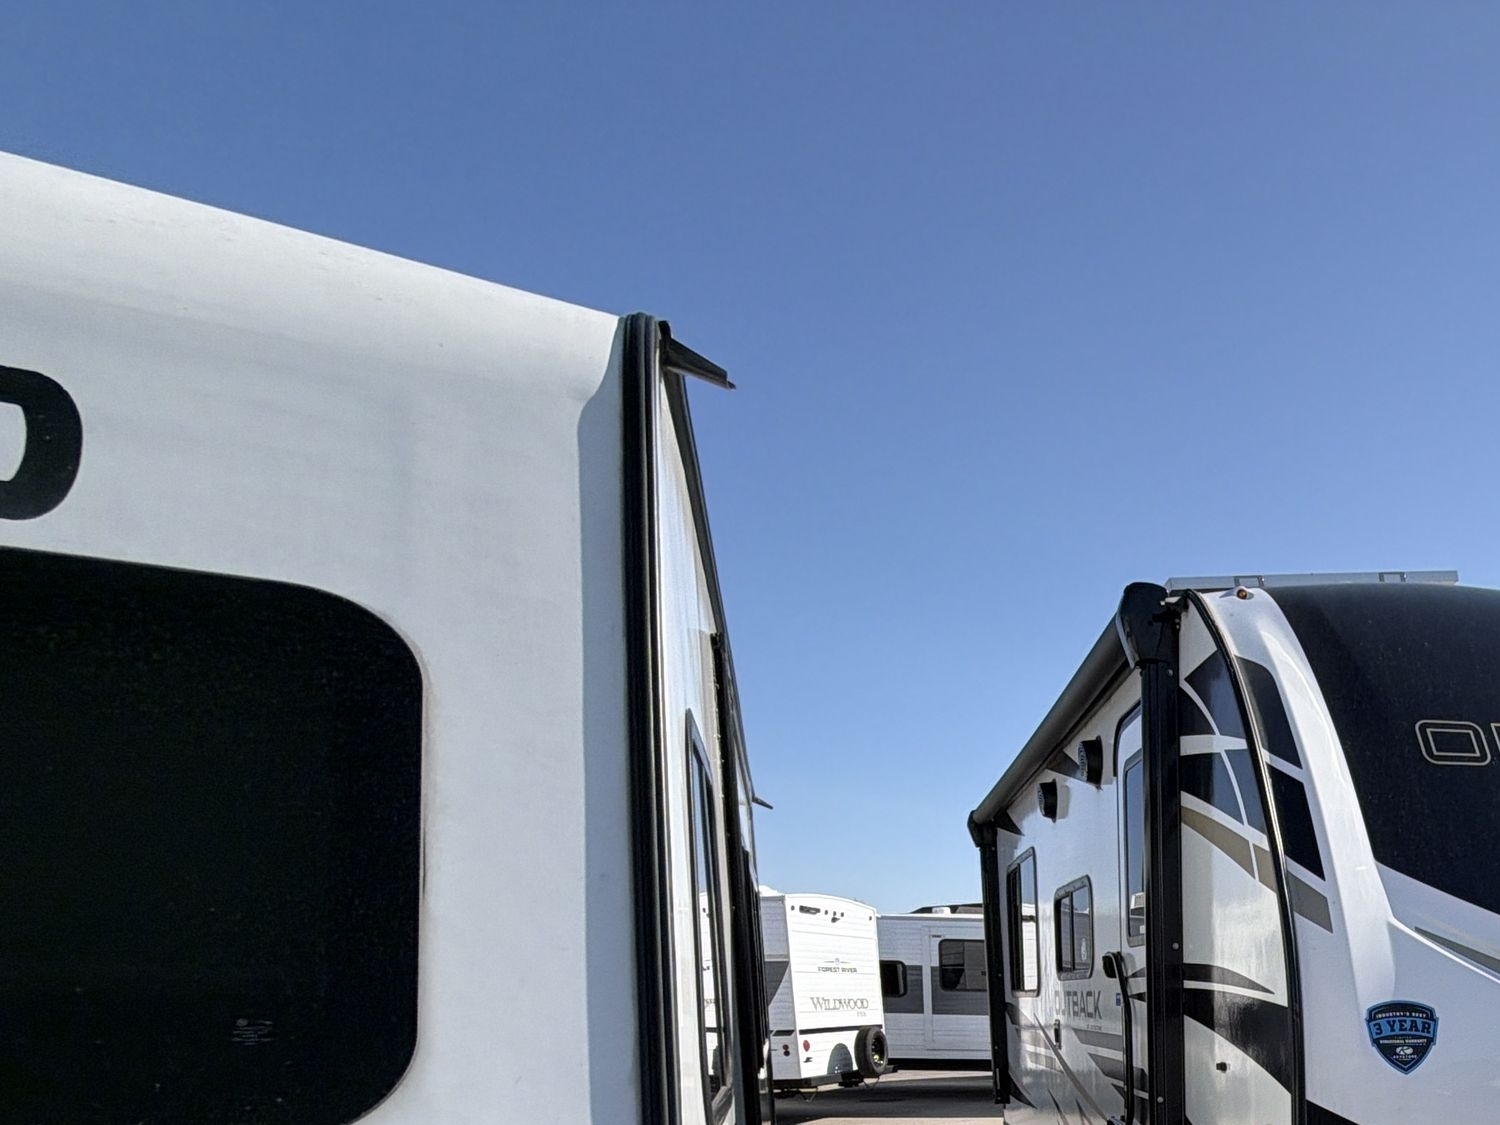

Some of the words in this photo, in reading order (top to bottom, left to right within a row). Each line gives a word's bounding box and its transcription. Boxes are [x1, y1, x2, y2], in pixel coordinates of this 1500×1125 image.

[810, 996, 869, 1011] WILDWOOD
[1373, 1022, 1383, 1036] 3
[1386, 1019, 1431, 1035] YEAR
